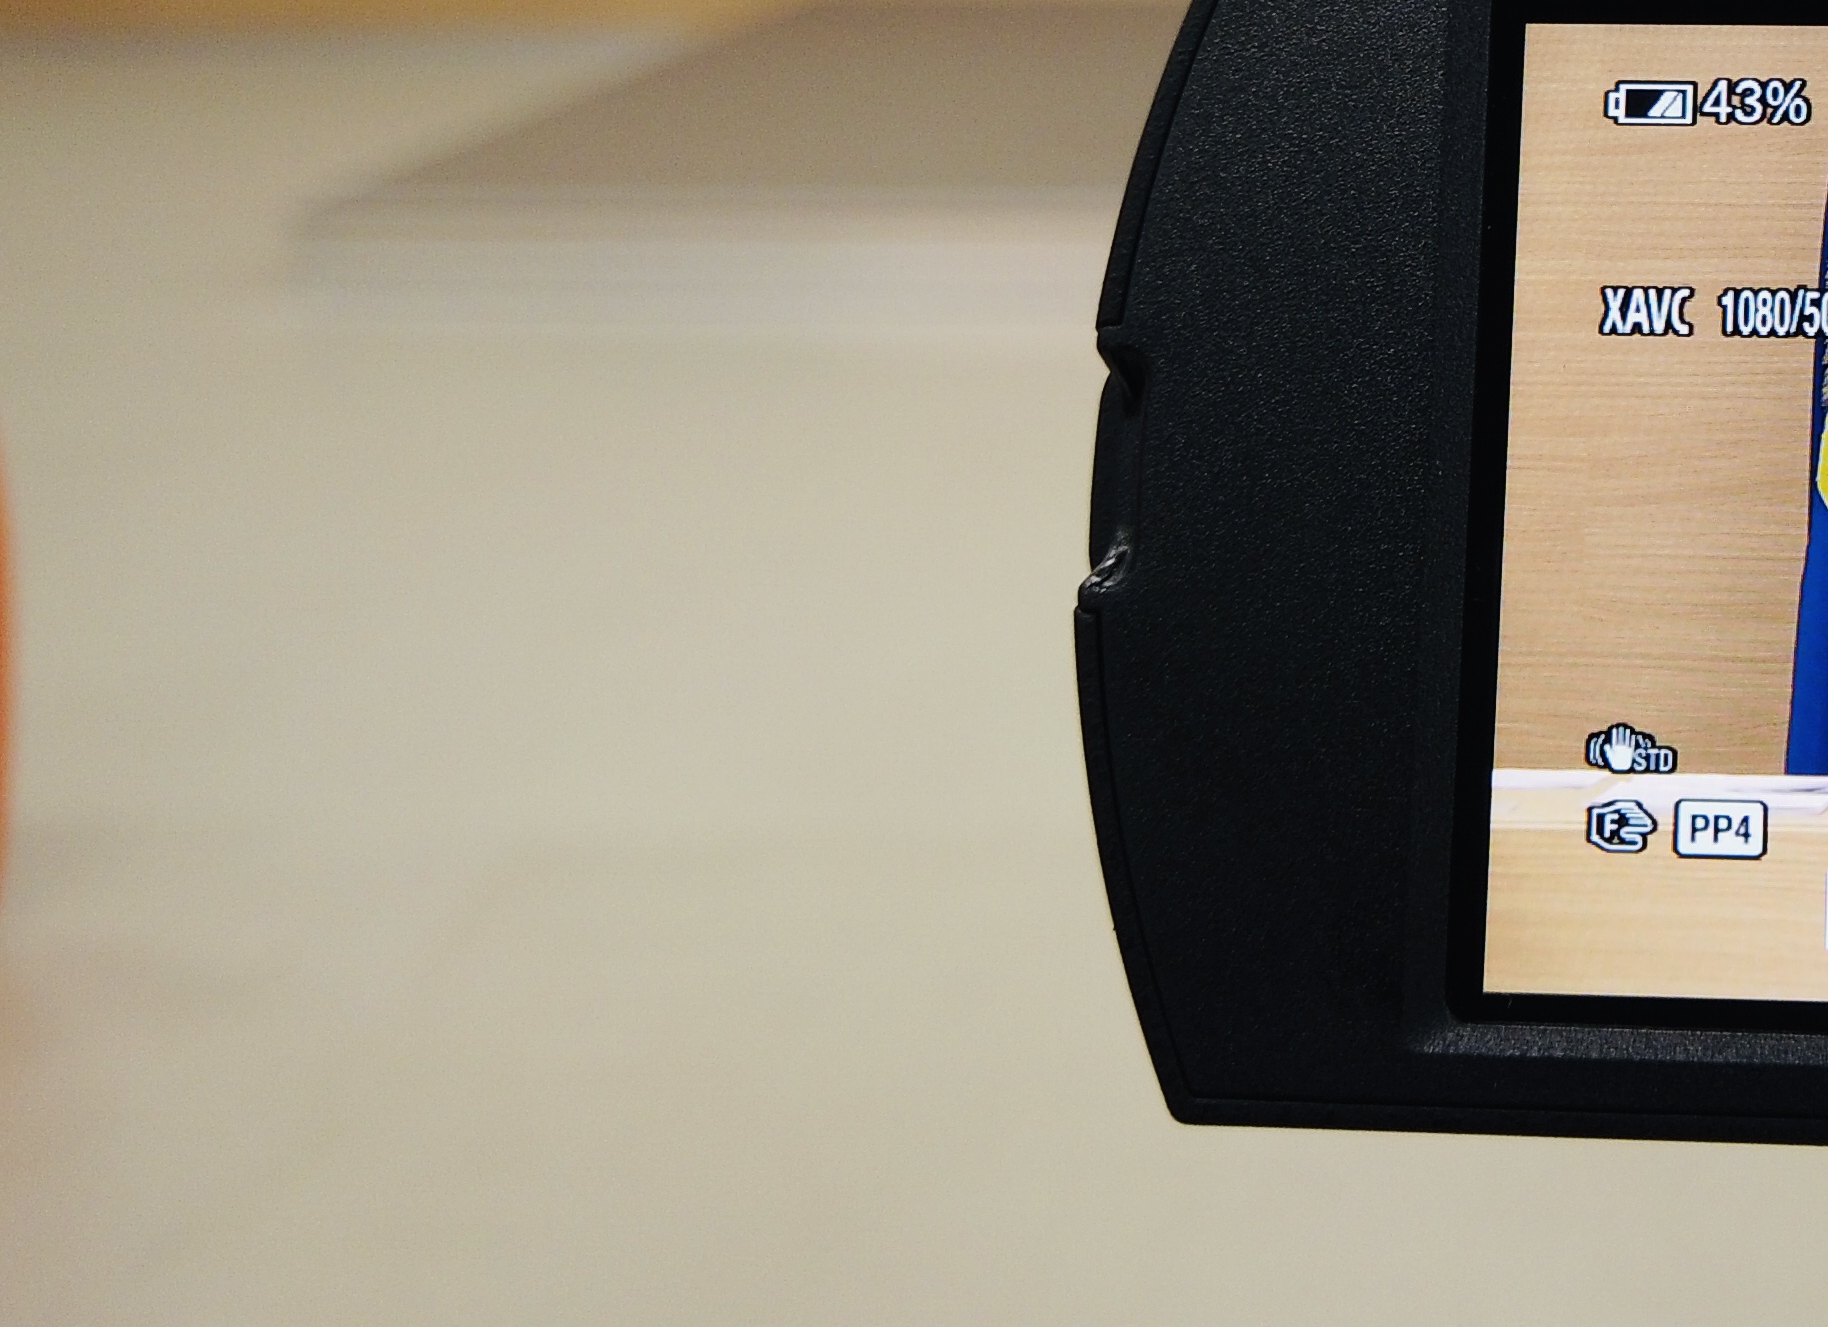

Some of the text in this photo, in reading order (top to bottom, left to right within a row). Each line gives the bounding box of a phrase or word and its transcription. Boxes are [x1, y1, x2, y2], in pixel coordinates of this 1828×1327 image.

[1701, 78, 1809, 124] 43%
[1602, 287, 1692, 335] XAVC
[1633, 747, 1675, 772] STD
[1690, 813, 1752, 844] PP4
